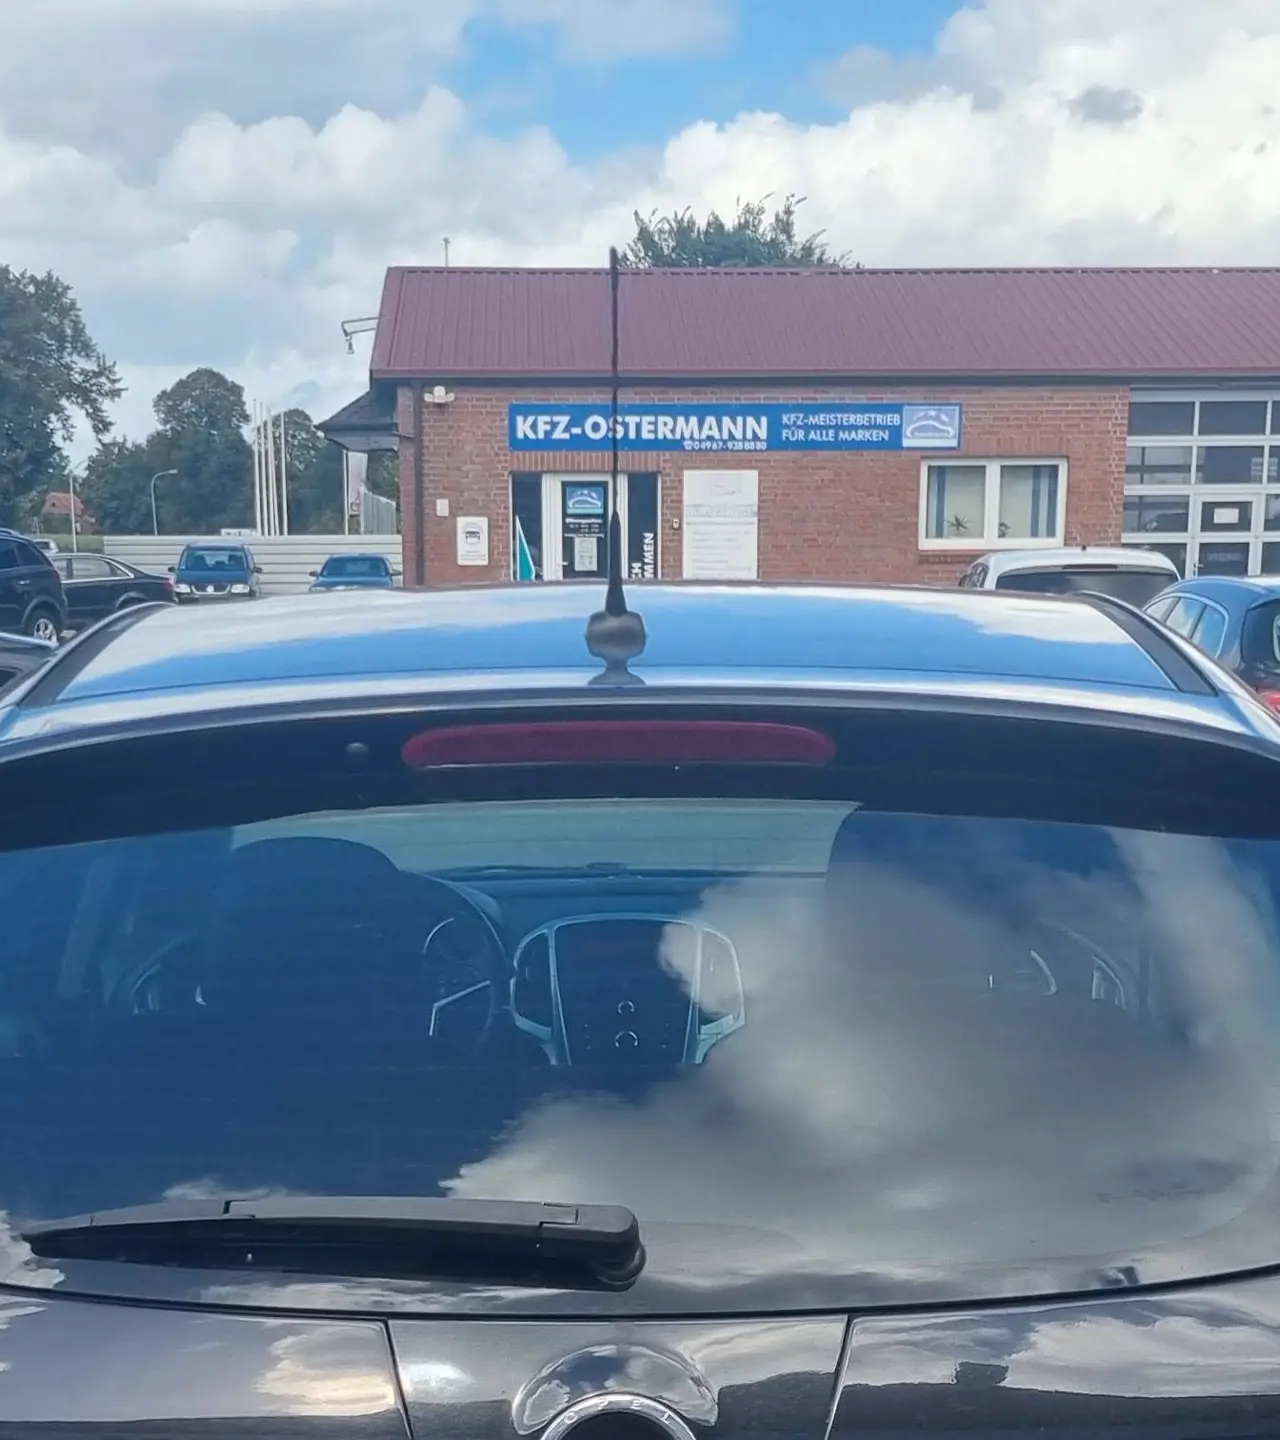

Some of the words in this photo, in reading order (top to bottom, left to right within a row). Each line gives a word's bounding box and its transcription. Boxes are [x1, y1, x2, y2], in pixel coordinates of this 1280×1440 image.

[782, 413, 901, 426] KFZ-MEISTERBETRIEB
[516, 415, 768, 440] KFZ-OSTERMANN
[782, 428, 805, 442] FÜR
[807, 429, 835, 442] ALLE
[838, 429, 889, 442] MARKEN
